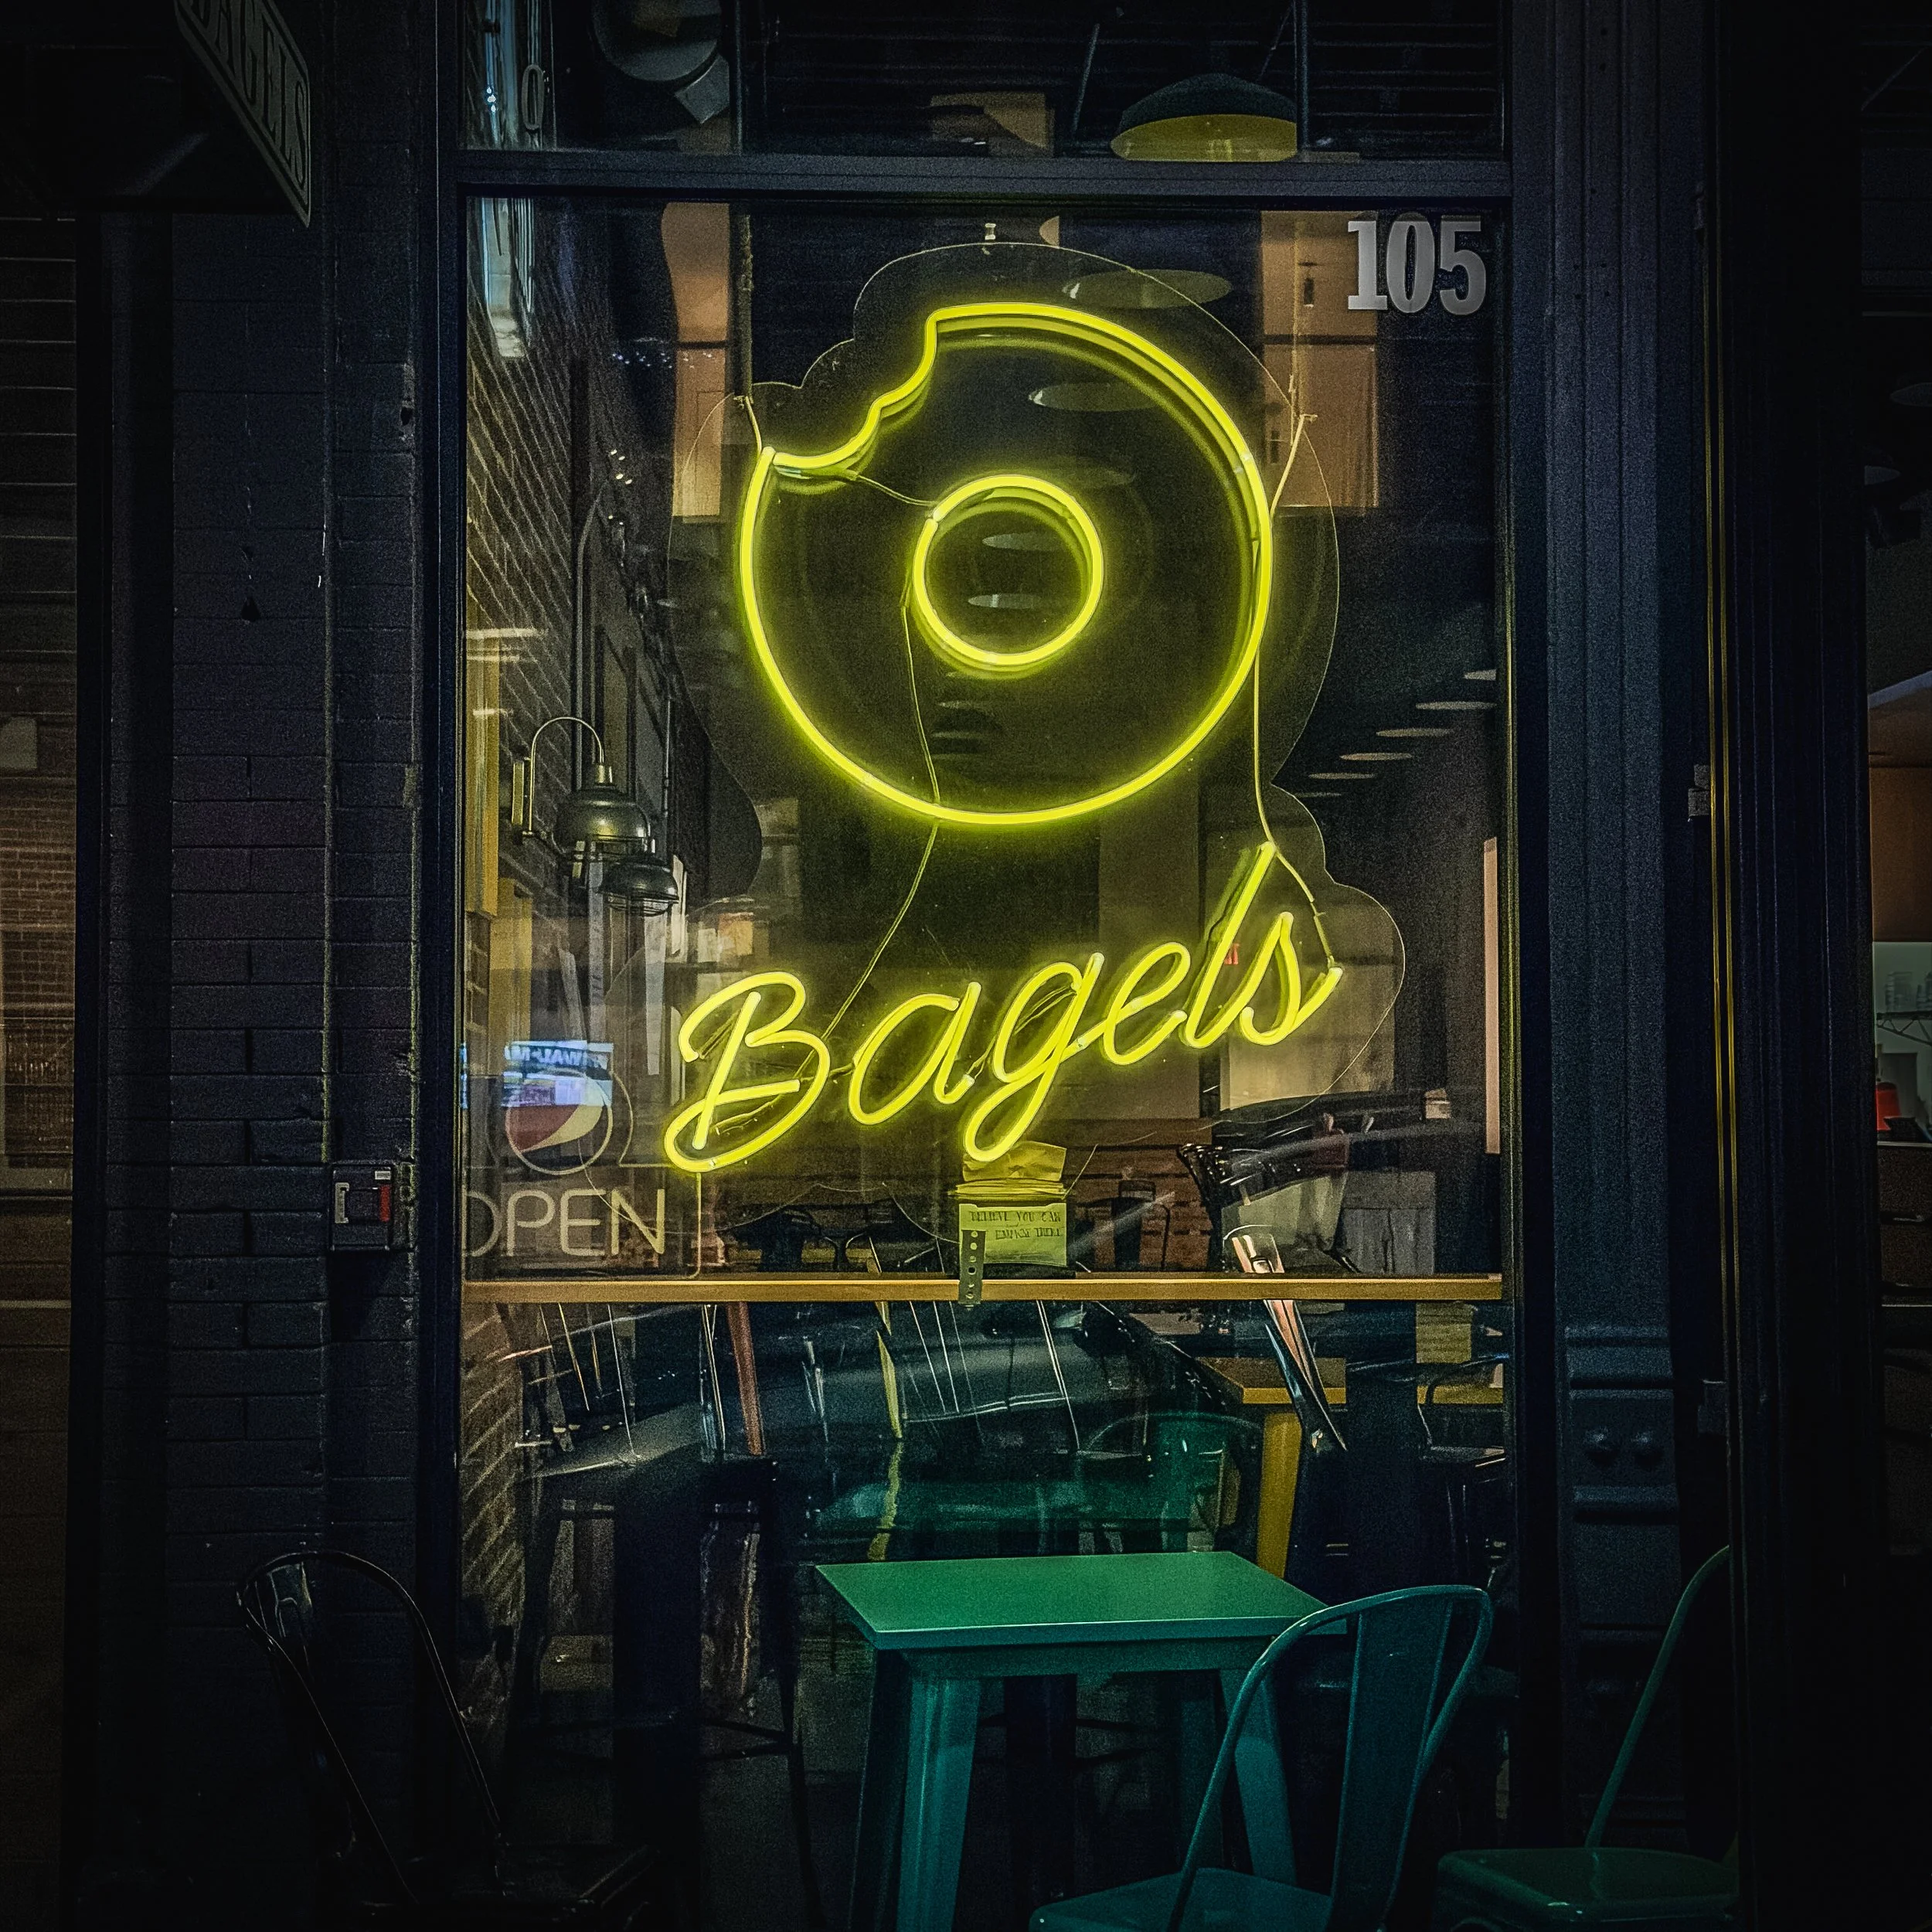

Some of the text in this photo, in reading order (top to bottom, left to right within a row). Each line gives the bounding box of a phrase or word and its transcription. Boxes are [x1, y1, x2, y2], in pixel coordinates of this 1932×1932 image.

[191, 0, 305, 190] AGELS
[1348, 212, 1486, 315] 105
[664, 839, 1344, 1172] Bagels
